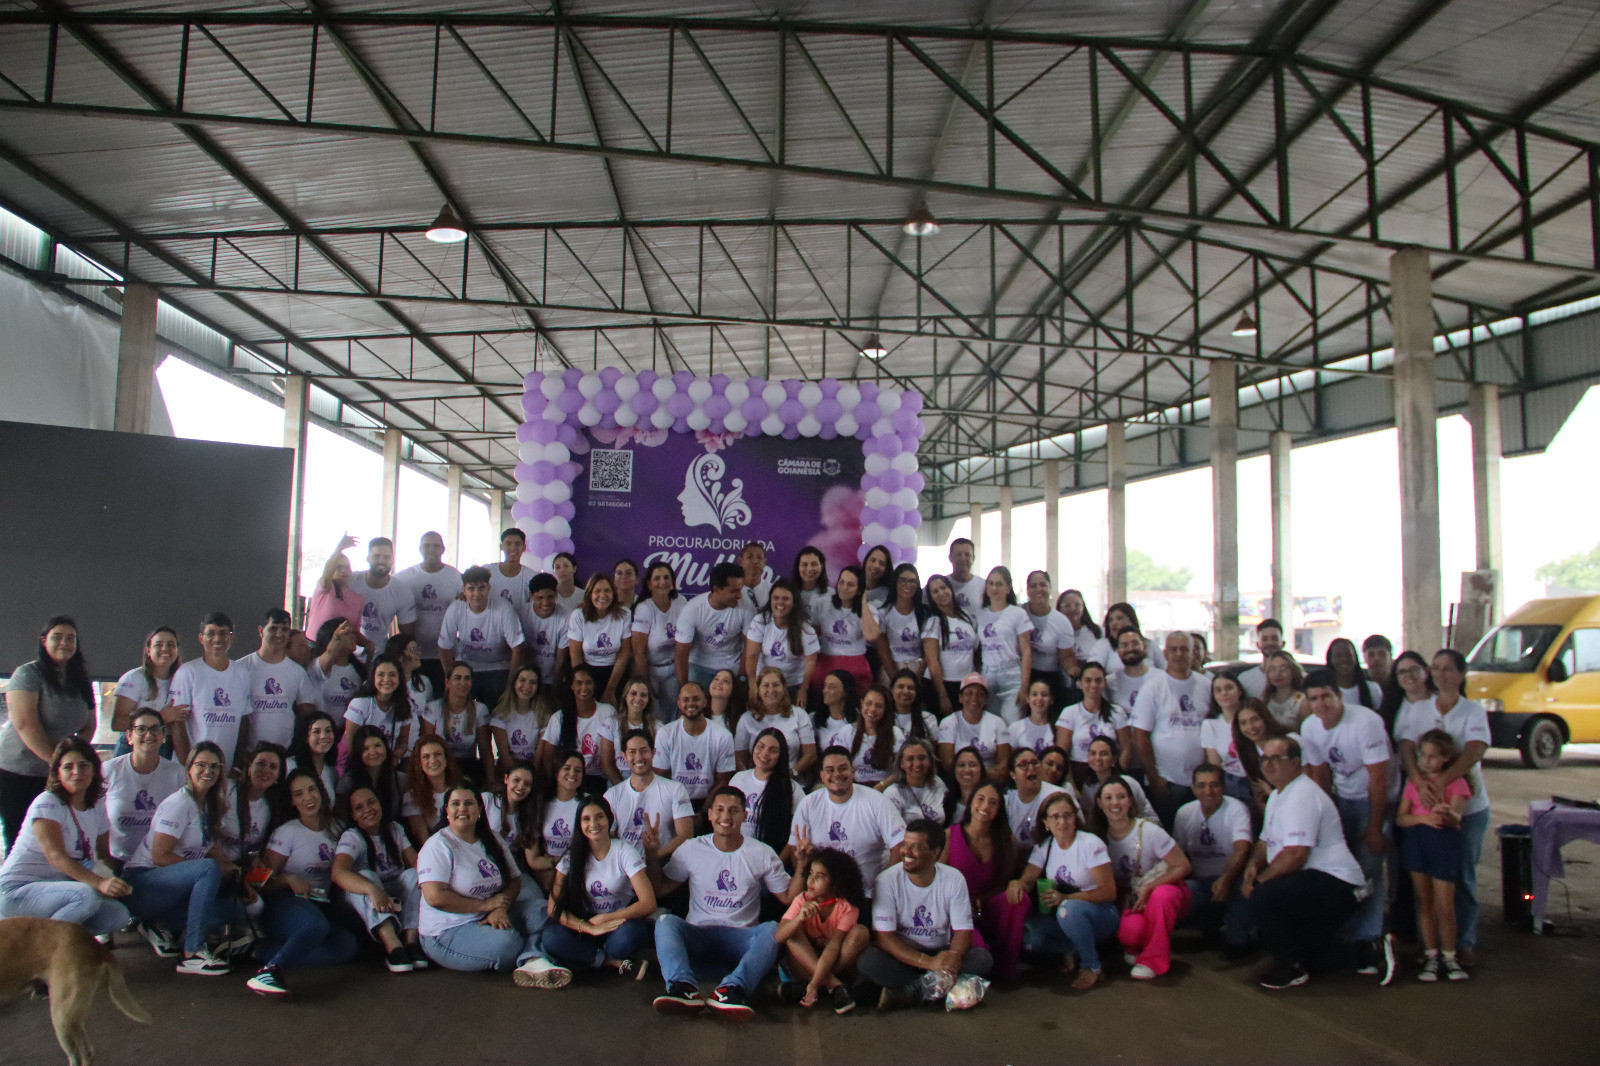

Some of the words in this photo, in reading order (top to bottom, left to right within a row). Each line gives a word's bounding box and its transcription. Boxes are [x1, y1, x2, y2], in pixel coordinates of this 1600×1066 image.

[254, 699, 288, 709] Mulher
[203, 711, 236, 723] Mulher
[703, 895, 743, 909] Mulher
